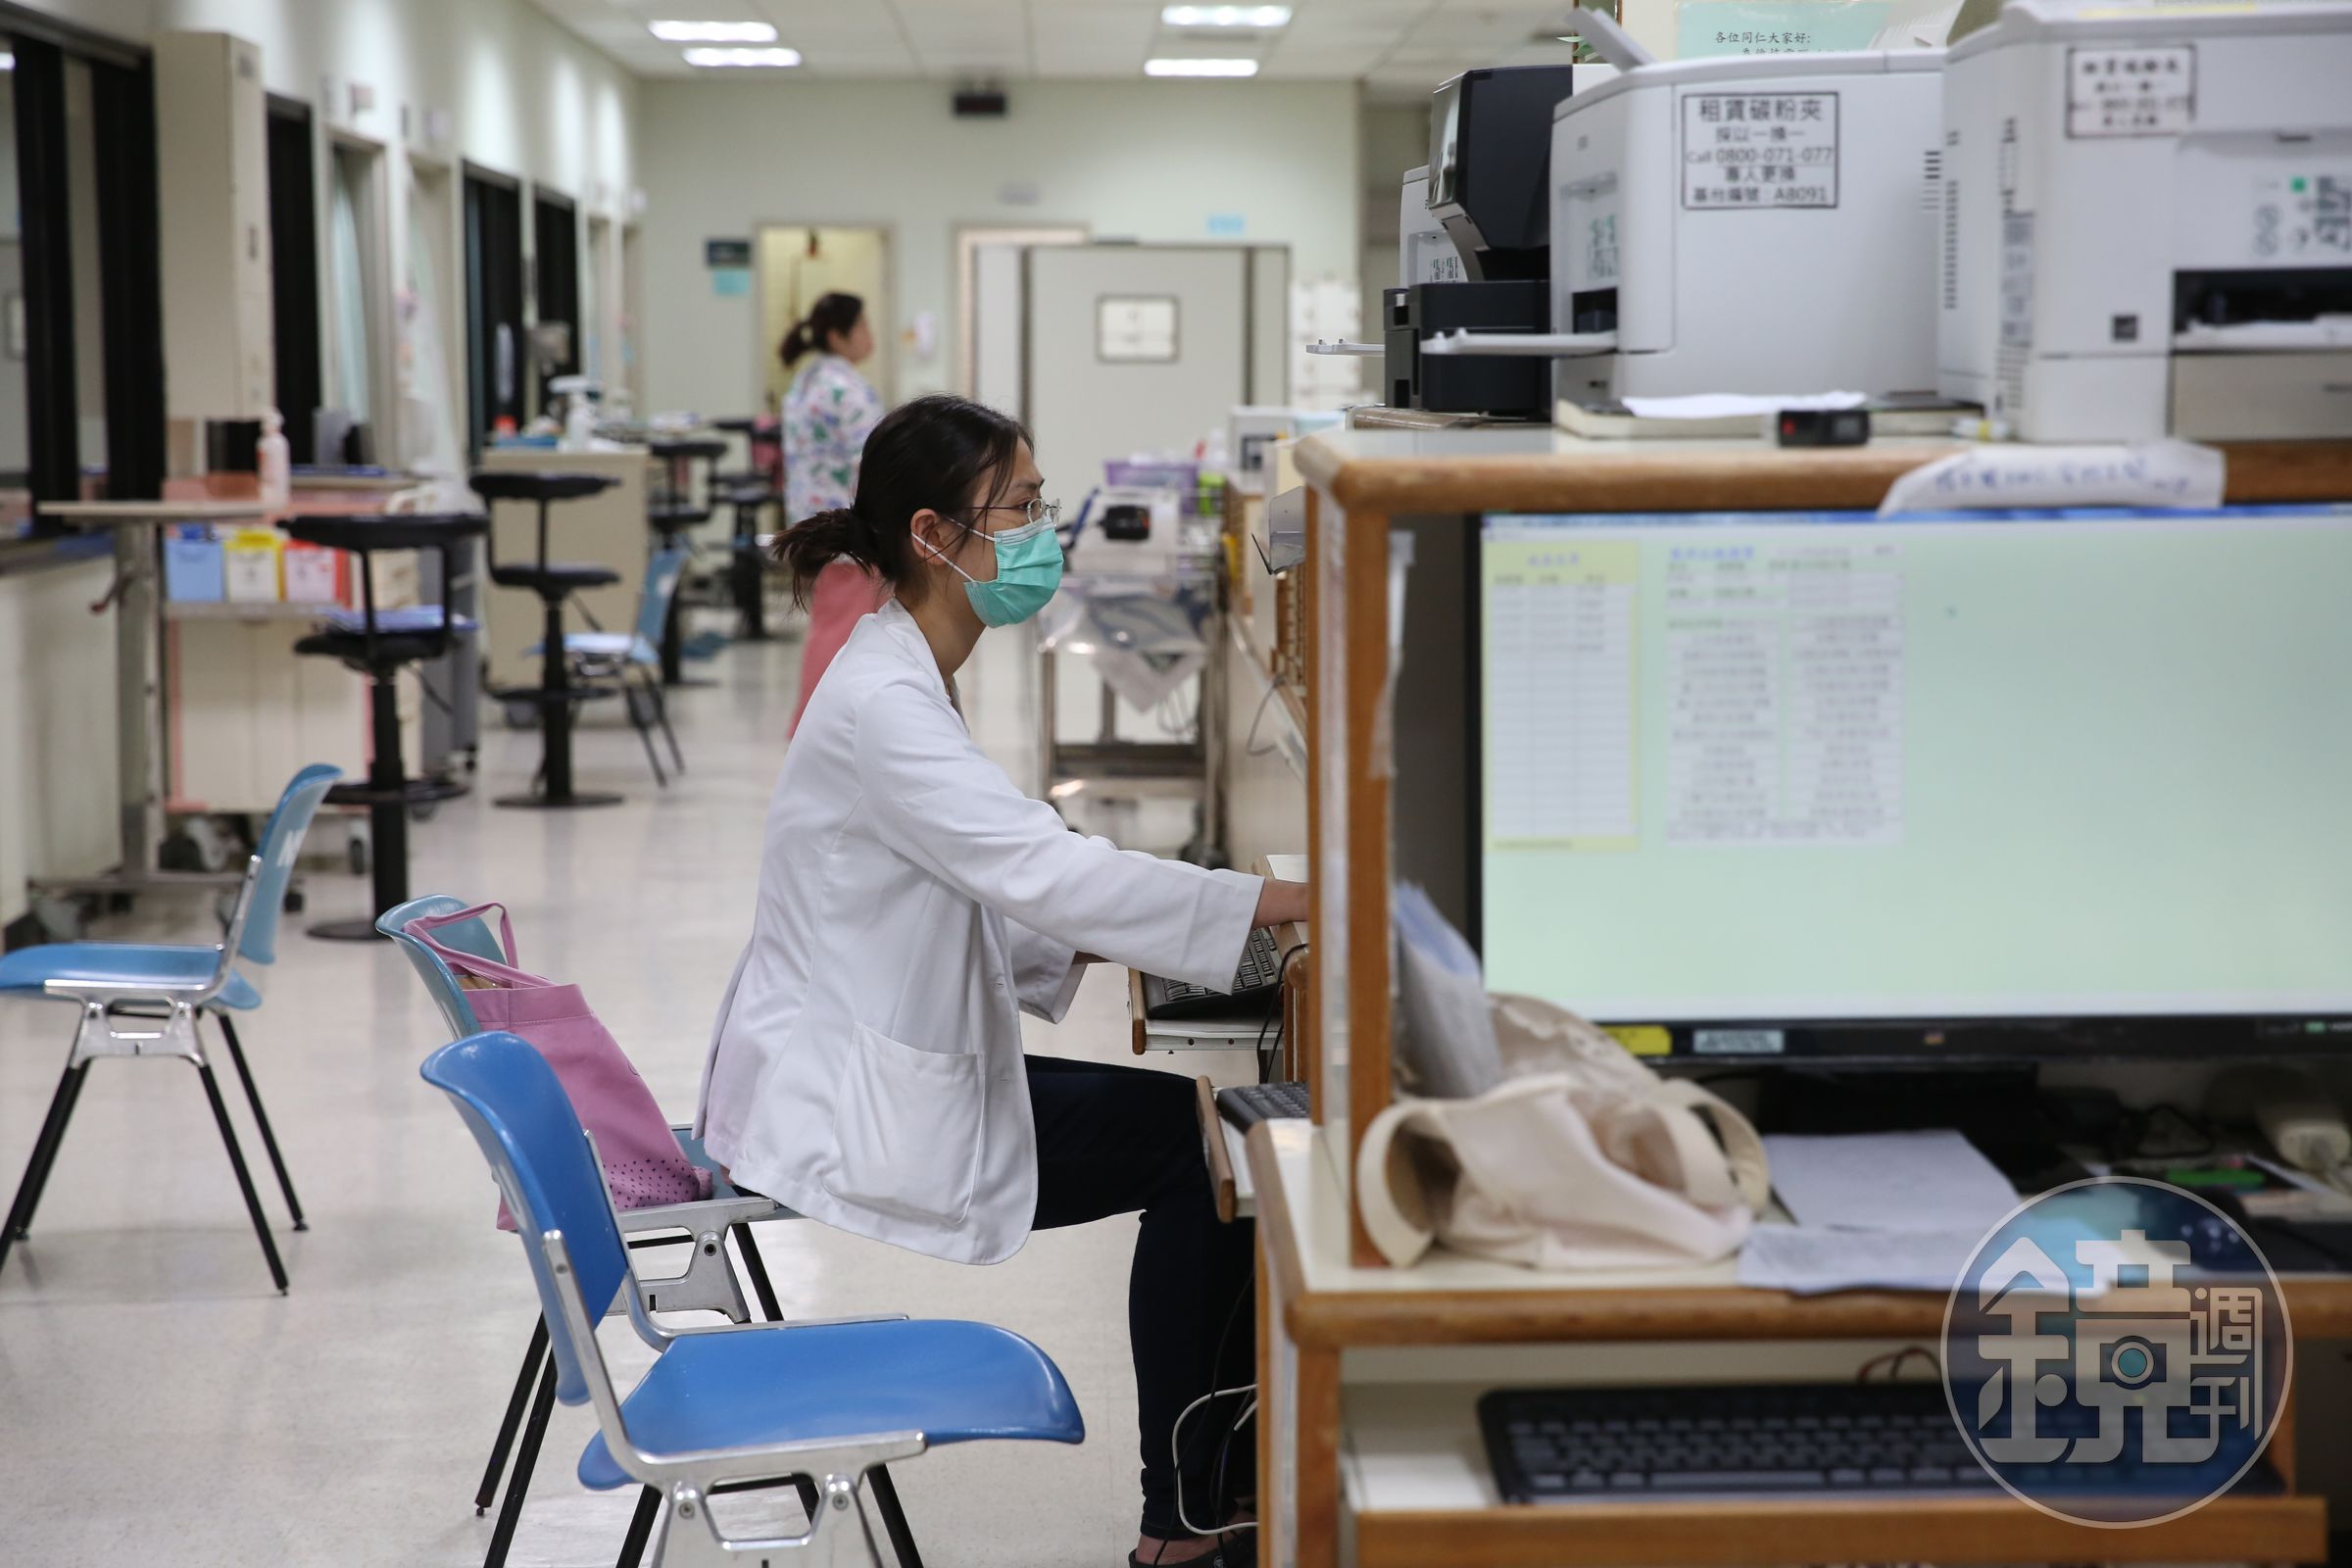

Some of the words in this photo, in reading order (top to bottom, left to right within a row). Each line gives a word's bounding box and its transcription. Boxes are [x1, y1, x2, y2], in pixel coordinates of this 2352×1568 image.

[1715, 31, 1811, 44] 各位同仁大家好:
